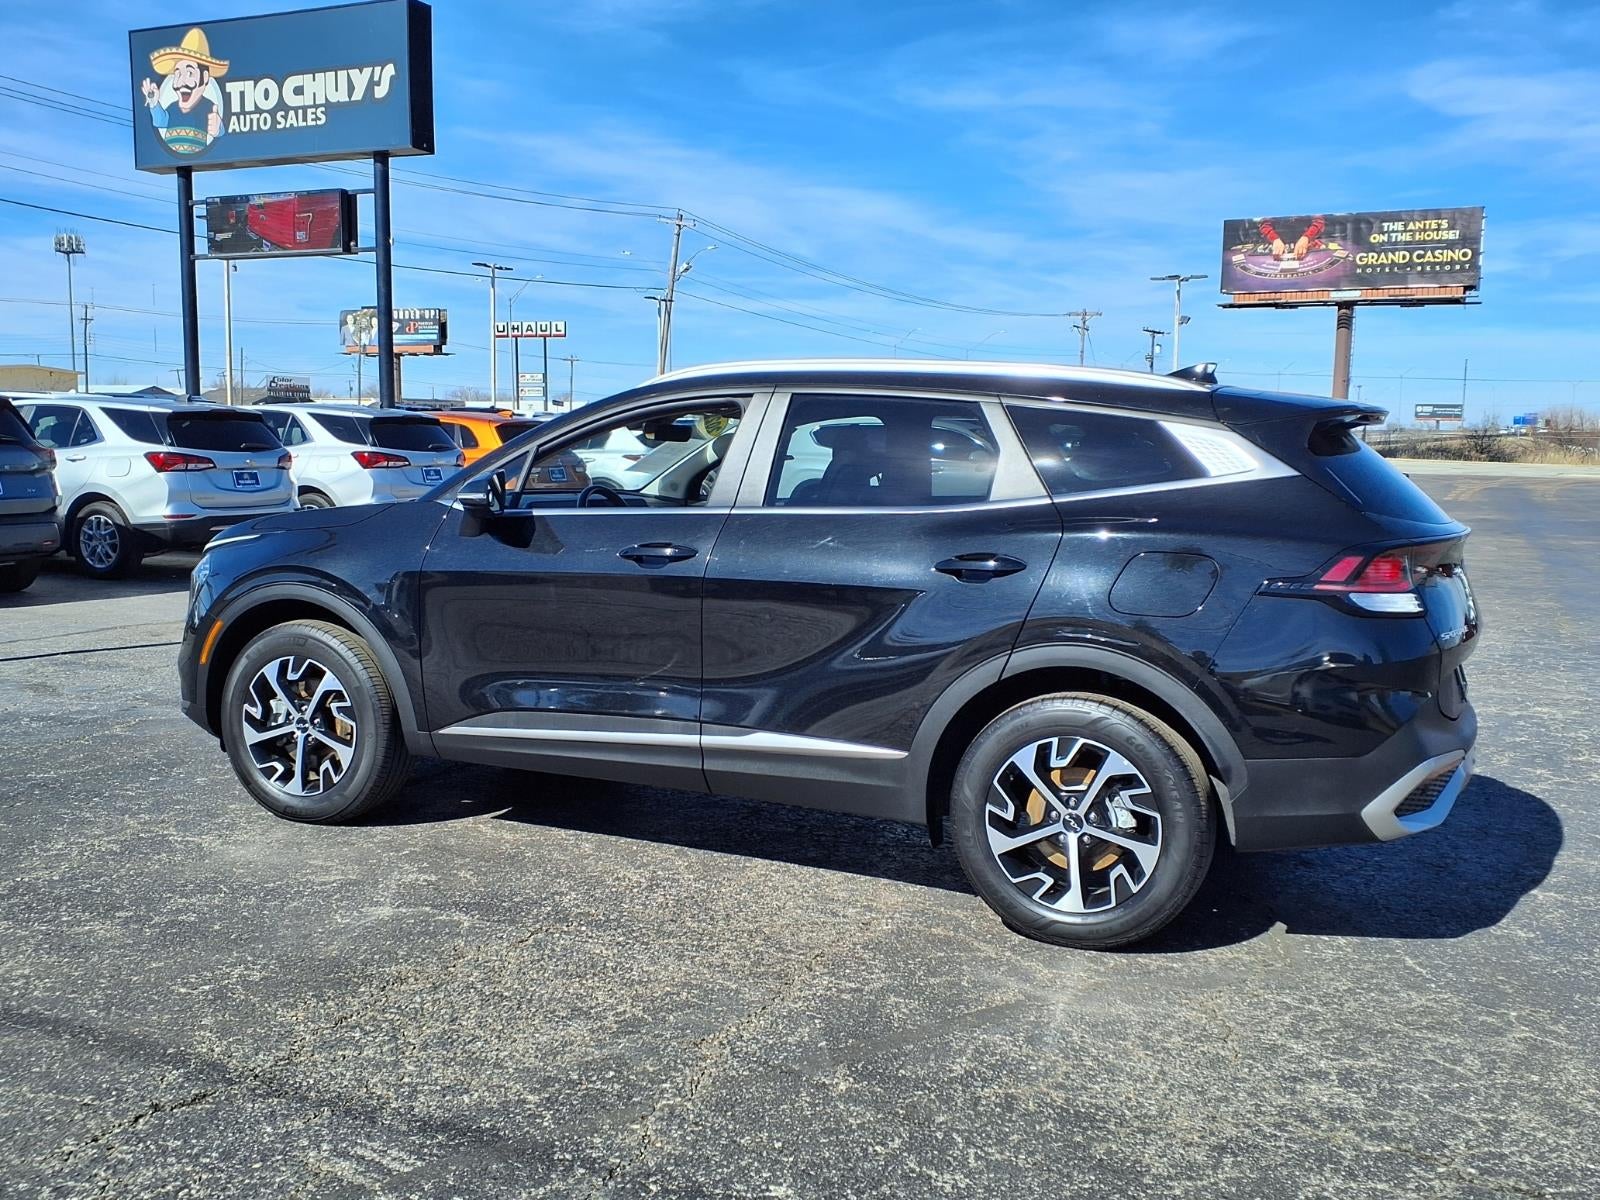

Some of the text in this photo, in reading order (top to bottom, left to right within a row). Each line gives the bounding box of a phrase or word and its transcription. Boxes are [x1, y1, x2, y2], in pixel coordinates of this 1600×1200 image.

[225, 63, 396, 113] TIO CHUY'S
[228, 107, 326, 134] AUTO SALES
[1382, 219, 1448, 232] THE ANTE'S
[1370, 230, 1460, 243] ON THE HOUSE!
[1356, 248, 1472, 265] GRAND CASINO
